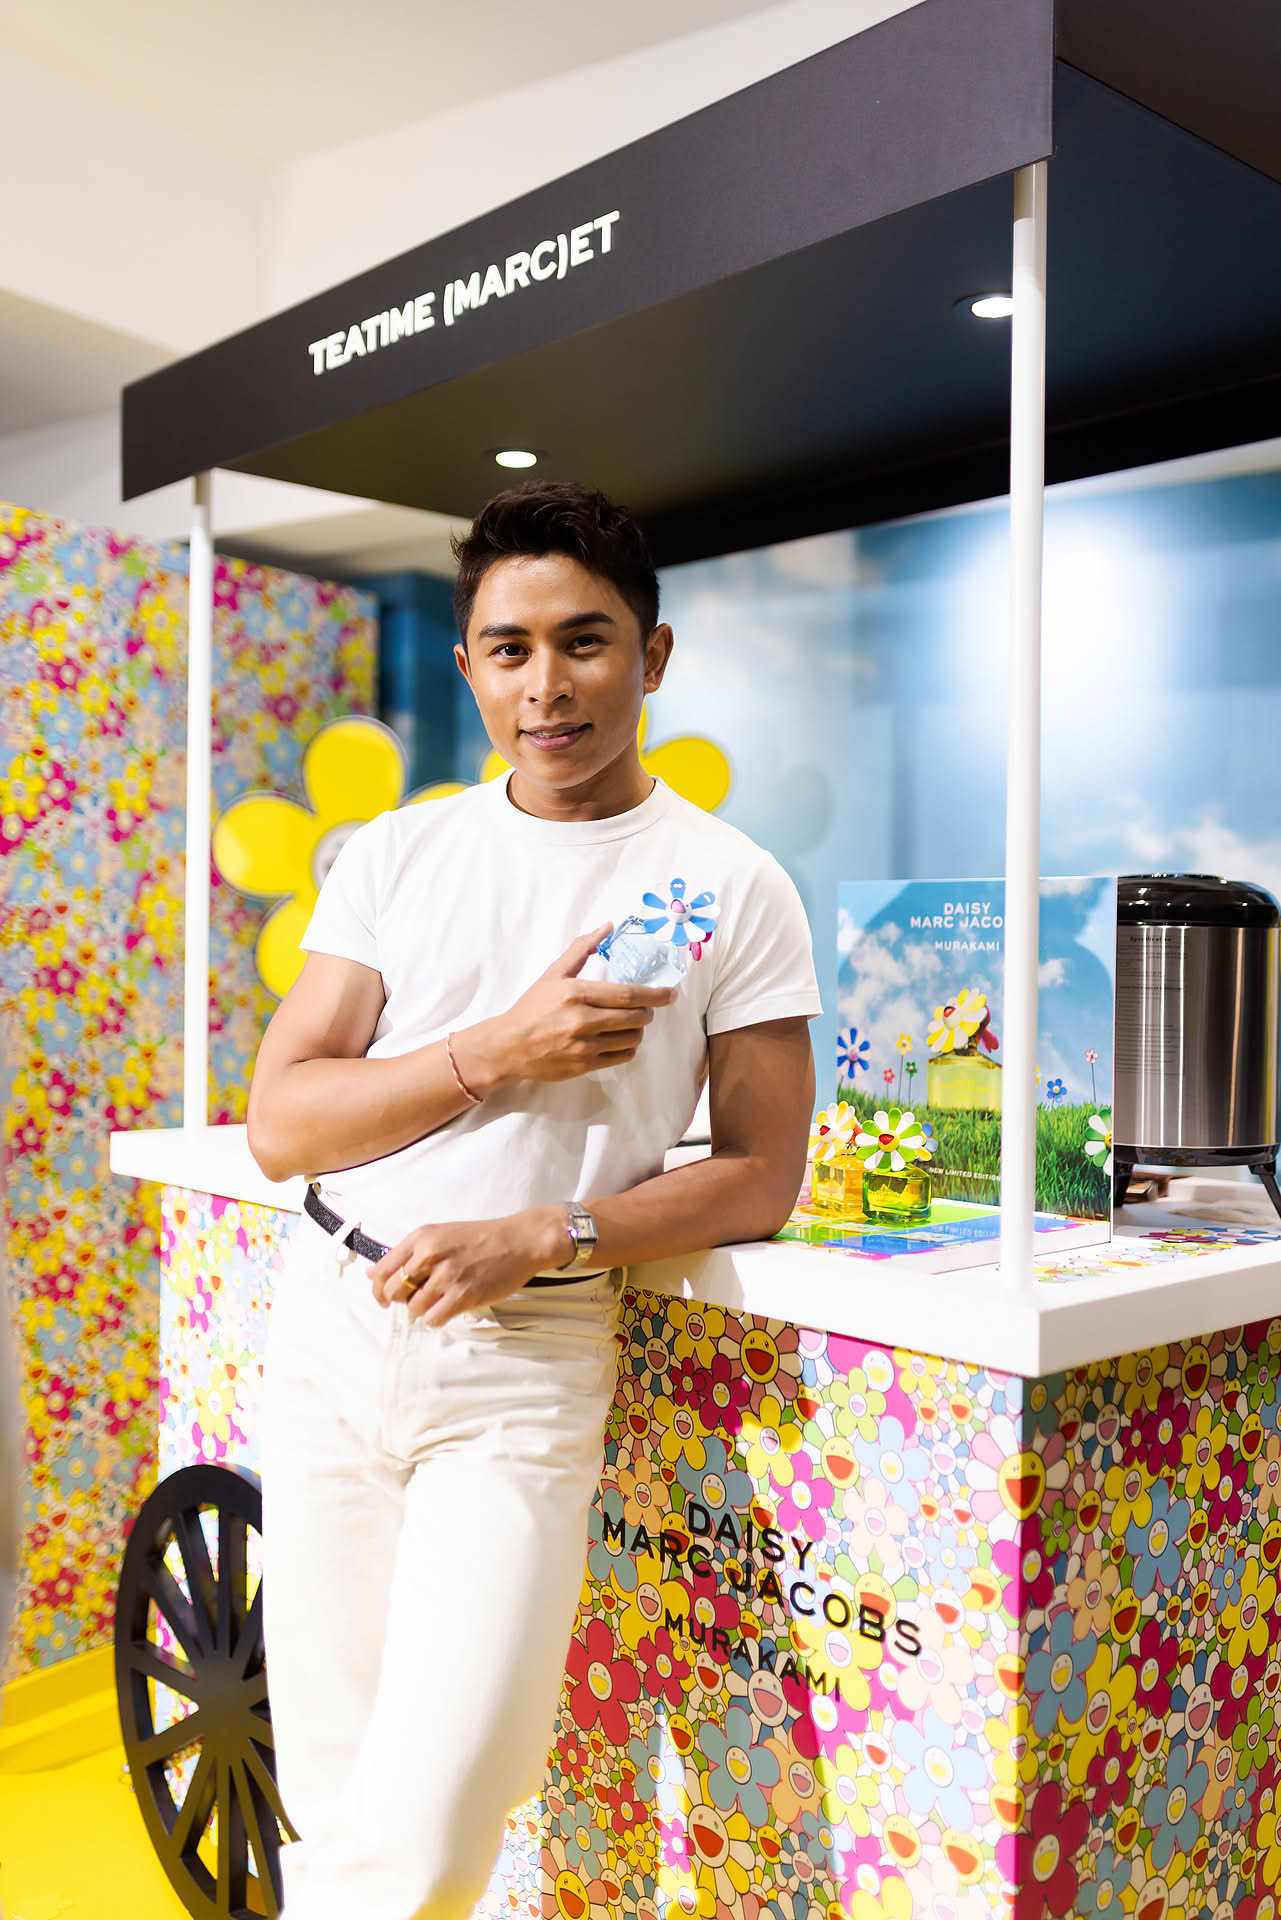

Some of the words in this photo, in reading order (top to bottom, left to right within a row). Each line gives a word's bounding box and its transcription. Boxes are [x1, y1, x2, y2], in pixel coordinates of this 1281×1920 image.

[308, 291, 435, 376] TEATIME
[444, 210, 620, 326] (MARC)ET
[910, 916, 954, 928] MARC
[959, 916, 1005, 928] JACO
[943, 902, 991, 915] DAISY
[935, 941, 1000, 951] MURAKAMI
[945, 1169, 972, 1177] LIMITED
[973, 1173, 1001, 1181] EDITION
[688, 1502, 813, 1571] DAISY
[603, 1511, 711, 1578] MARC
[731, 1562, 923, 1656] JACOBS
[664, 1607, 841, 1702] MURAKAMI
